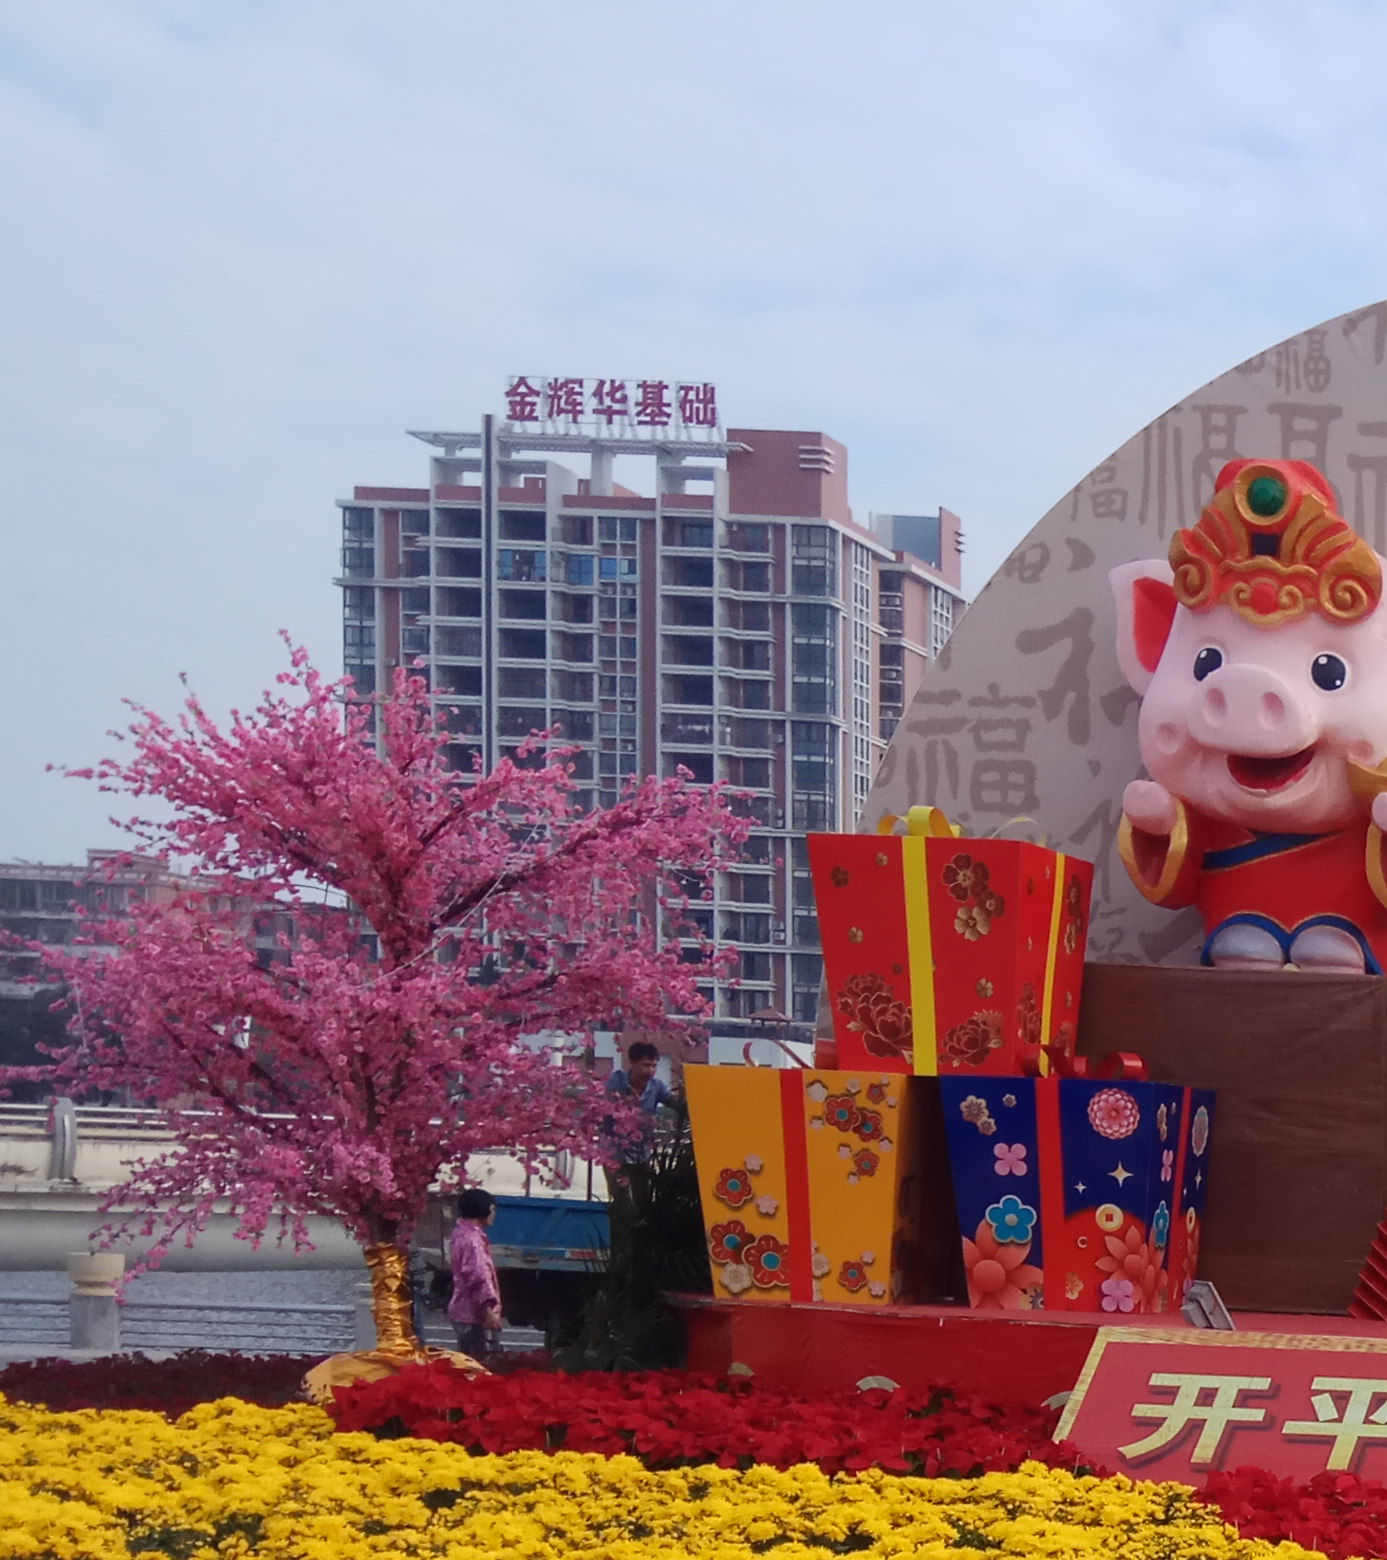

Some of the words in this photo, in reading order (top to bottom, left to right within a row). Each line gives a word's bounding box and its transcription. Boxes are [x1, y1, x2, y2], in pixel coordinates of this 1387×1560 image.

[505, 376, 717, 427] 金辉华基础
